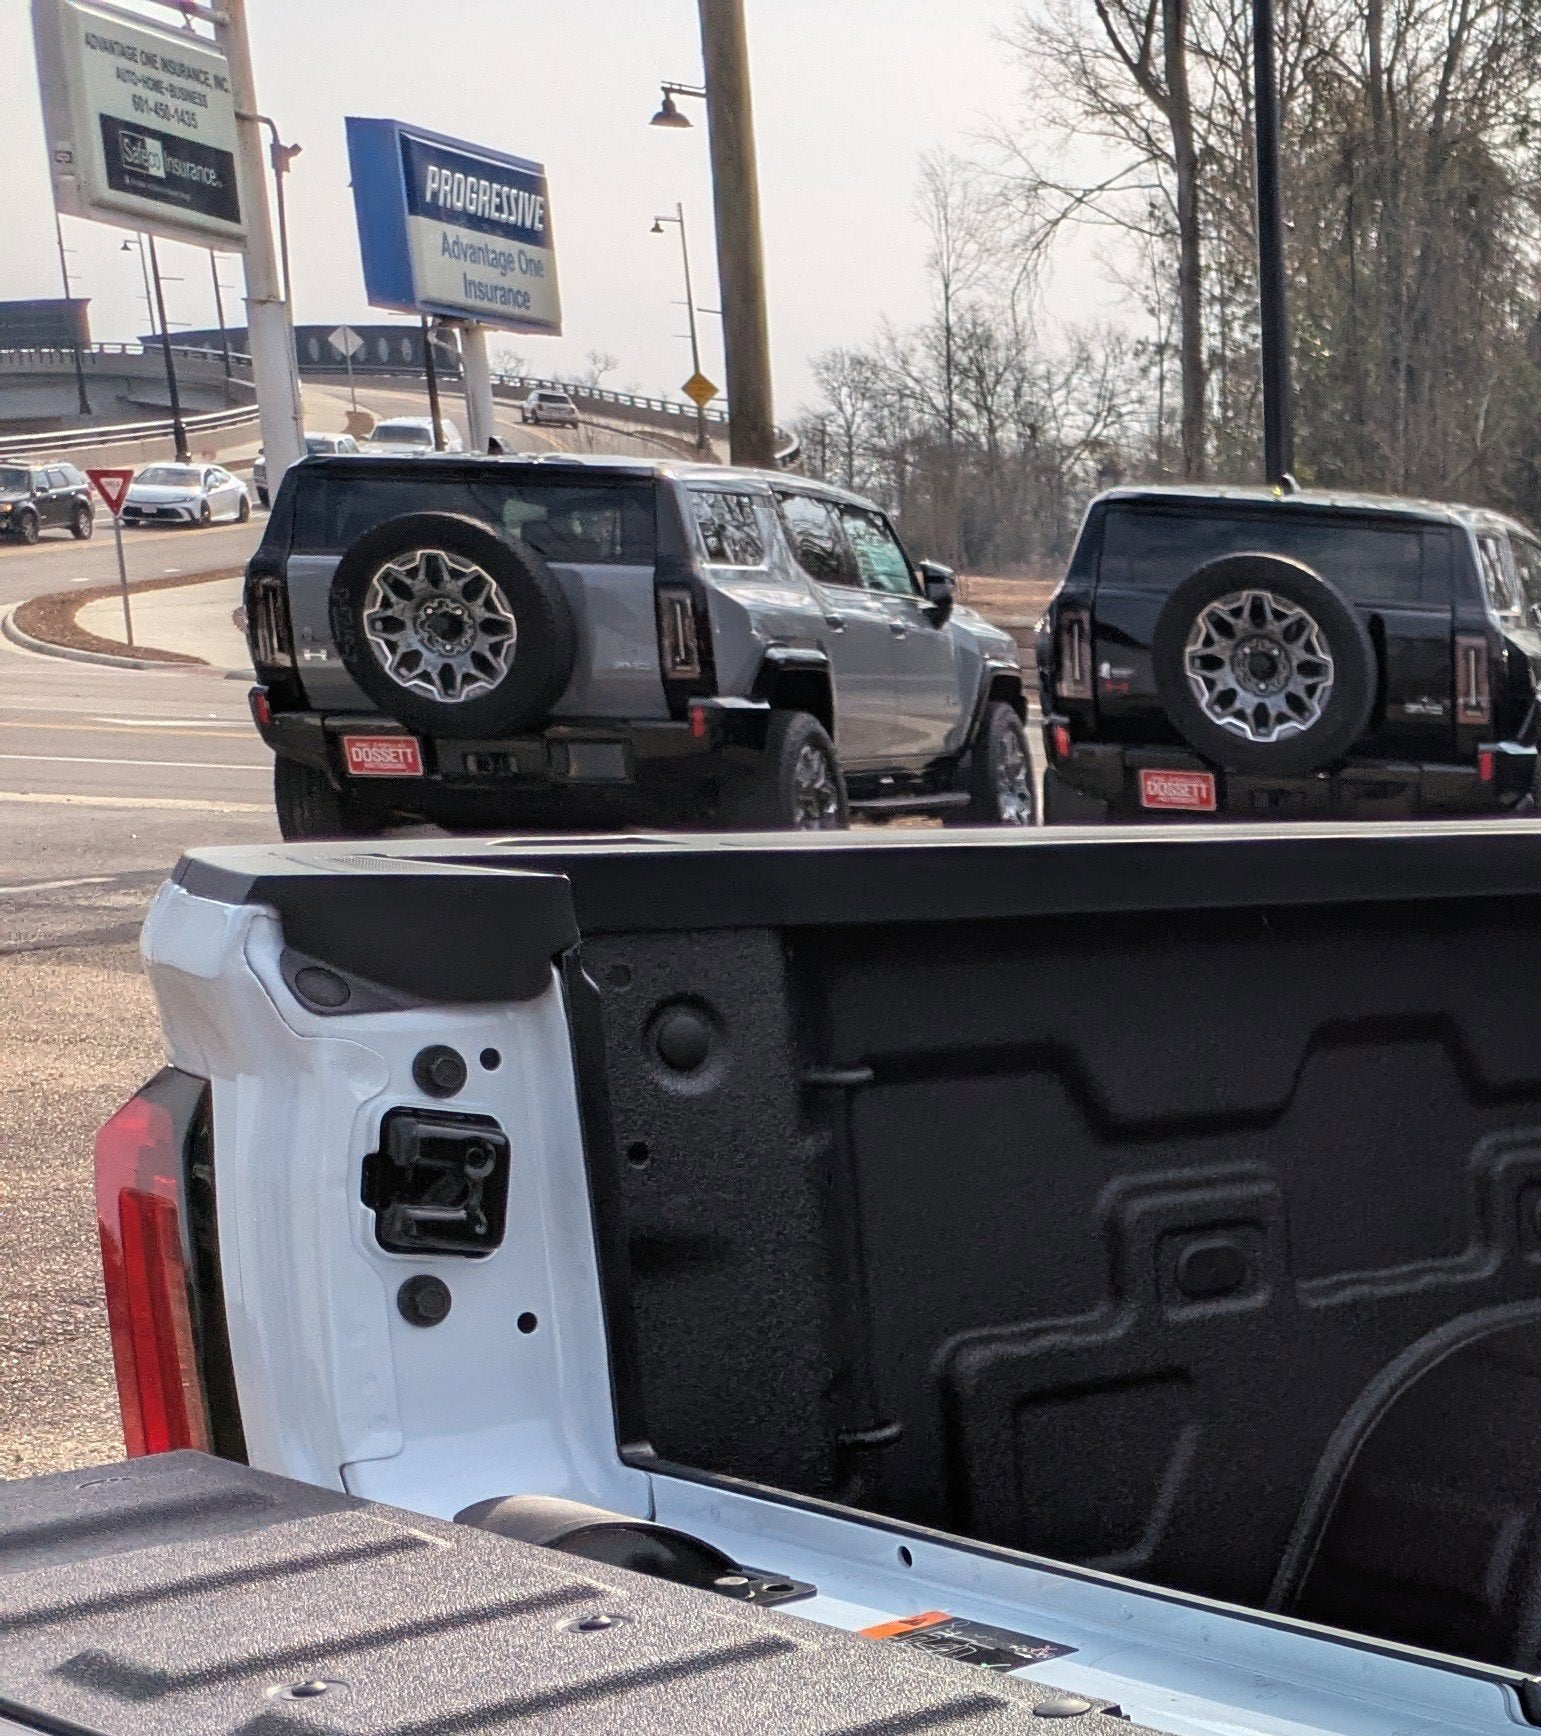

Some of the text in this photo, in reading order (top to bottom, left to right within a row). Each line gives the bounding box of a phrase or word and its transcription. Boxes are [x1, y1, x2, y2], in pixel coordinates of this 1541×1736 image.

[123, 138, 161, 171] Safeco
[425, 165, 545, 232] PROGRESSIVE
[441, 231, 544, 279] Advantage One
[463, 271, 531, 311] Insurance
[351, 747, 413, 763] DOSSETT
